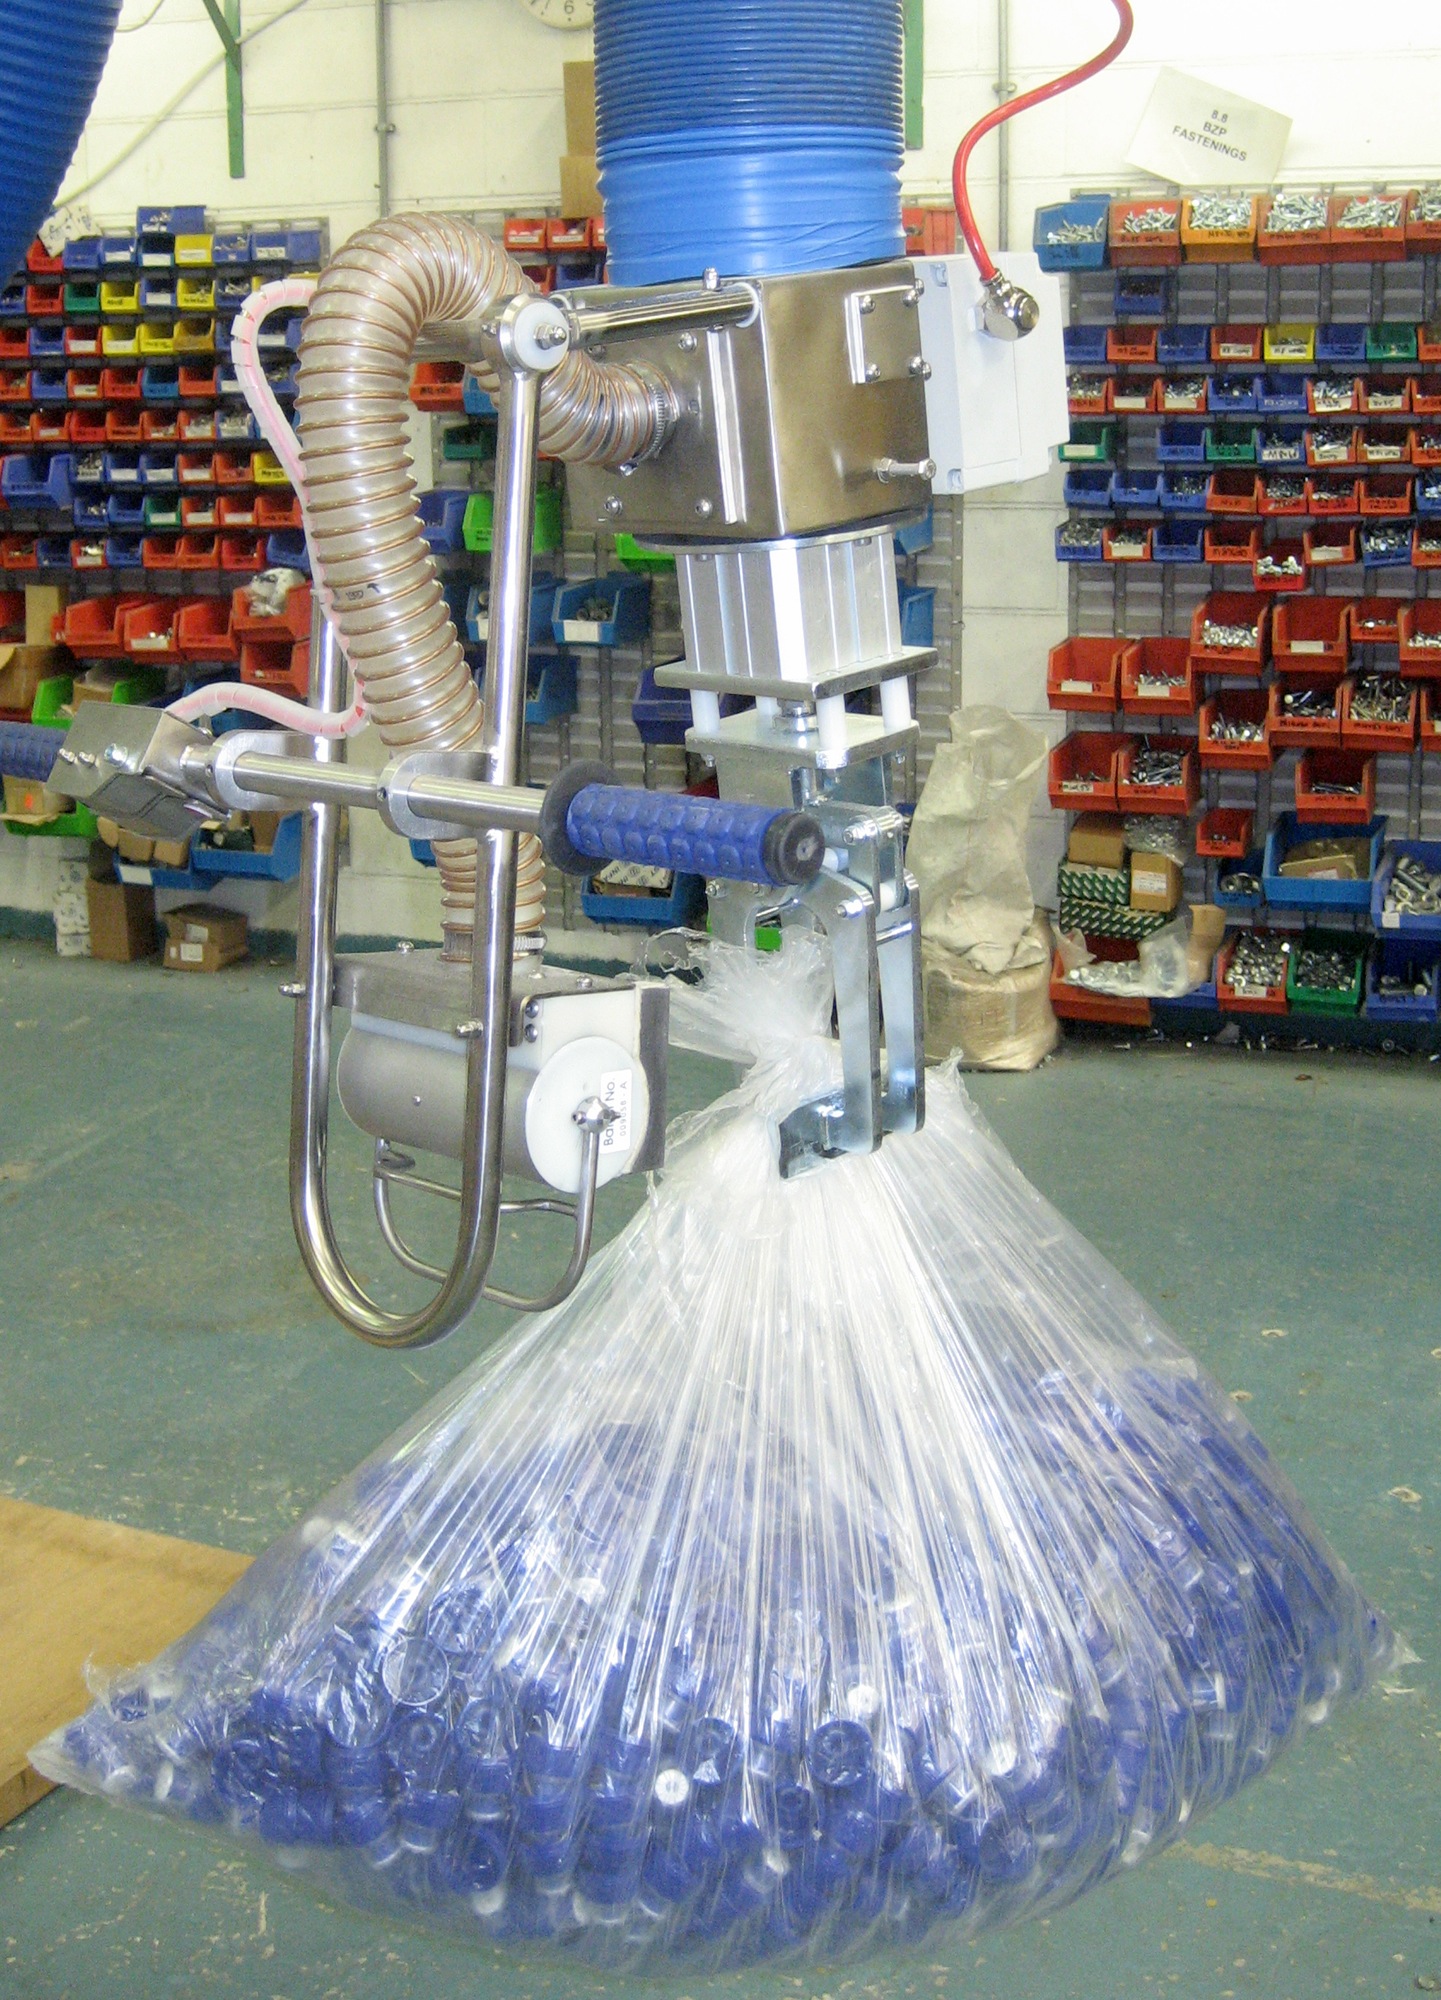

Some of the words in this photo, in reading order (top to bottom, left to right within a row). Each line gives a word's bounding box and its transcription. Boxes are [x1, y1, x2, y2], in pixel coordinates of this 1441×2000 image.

[1211, 110, 1228, 123] 8.8
[1202, 121, 1228, 137] BZP
[1172, 125, 1247, 162] FASTENINGS
